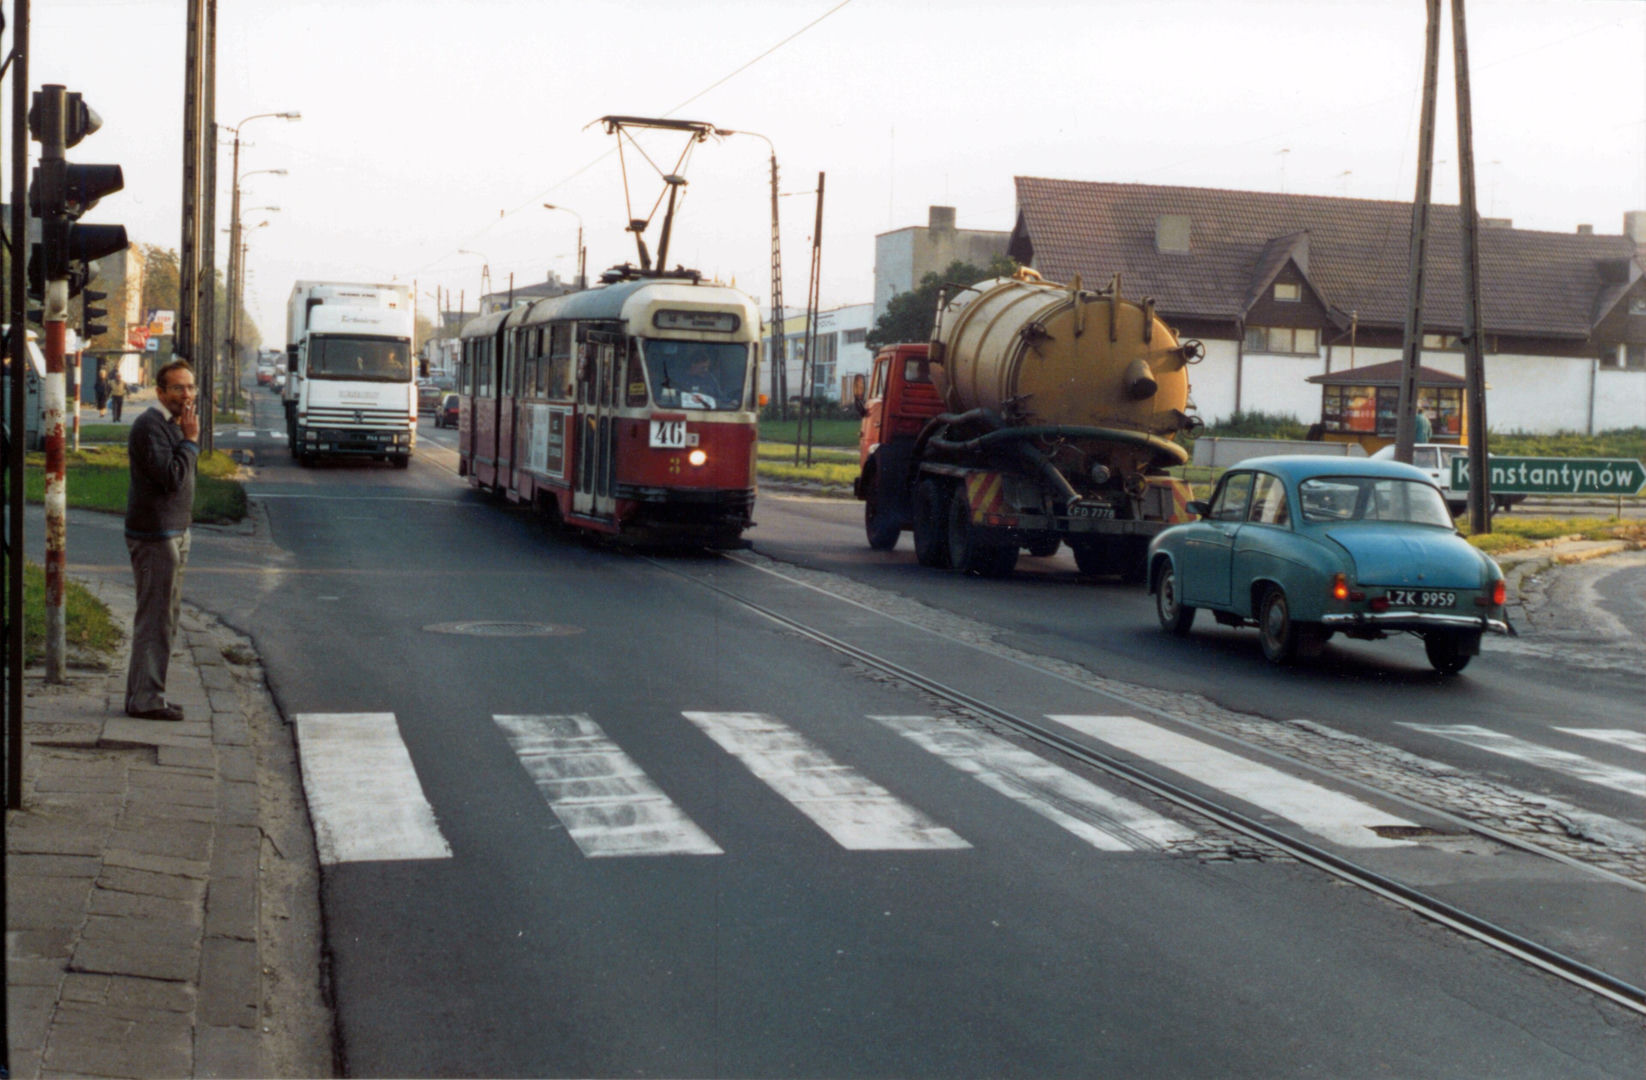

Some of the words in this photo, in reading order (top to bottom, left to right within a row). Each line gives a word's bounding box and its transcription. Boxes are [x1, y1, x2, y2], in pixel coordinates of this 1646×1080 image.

[655, 420, 682, 445] 46
[1457, 459, 1633, 493] Knstantynów
[1386, 591, 1416, 606] LZK
[1422, 592, 1456, 607] 9959
